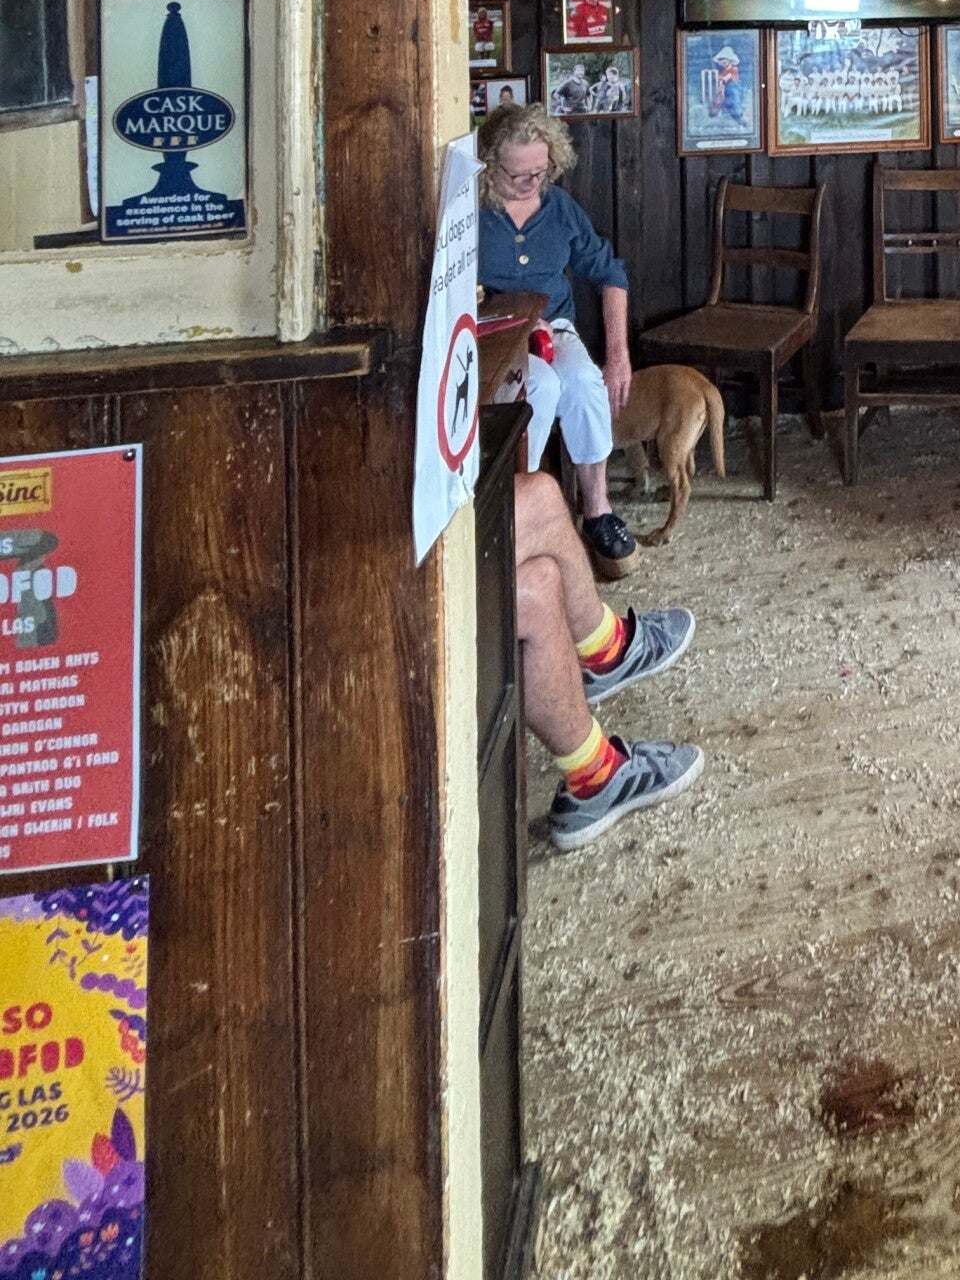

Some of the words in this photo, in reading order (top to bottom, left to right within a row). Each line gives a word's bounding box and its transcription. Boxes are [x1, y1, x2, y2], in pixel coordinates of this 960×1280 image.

[143, 95, 205, 113] CASK
[125, 114, 226, 134] MARQUE
[140, 193, 191, 205] Awarded
[193, 192, 211, 202] for
[125, 205, 189, 215] excellence
[191, 203, 203, 212] in
[205, 202, 224, 212] the
[116, 215, 160, 227] serving
[162, 214, 175, 223] of
[177, 213, 205, 223] cask
[207, 211, 235, 221] beer
[2, 616, 35, 636] LAS
[15, 657, 60, 673] BOWEN
[65, 651, 100, 668] RHYS
[34, 694, 86, 712] GORDON
[34, 733, 98, 753] O'CONNOR
[30, 796, 74, 814] EVANS
[87, 812, 119, 828] FOLK
[2, 1002, 53, 1035] SO
[18, 1081, 62, 1108] LAS
[6, 1103, 70, 1133] 2026
